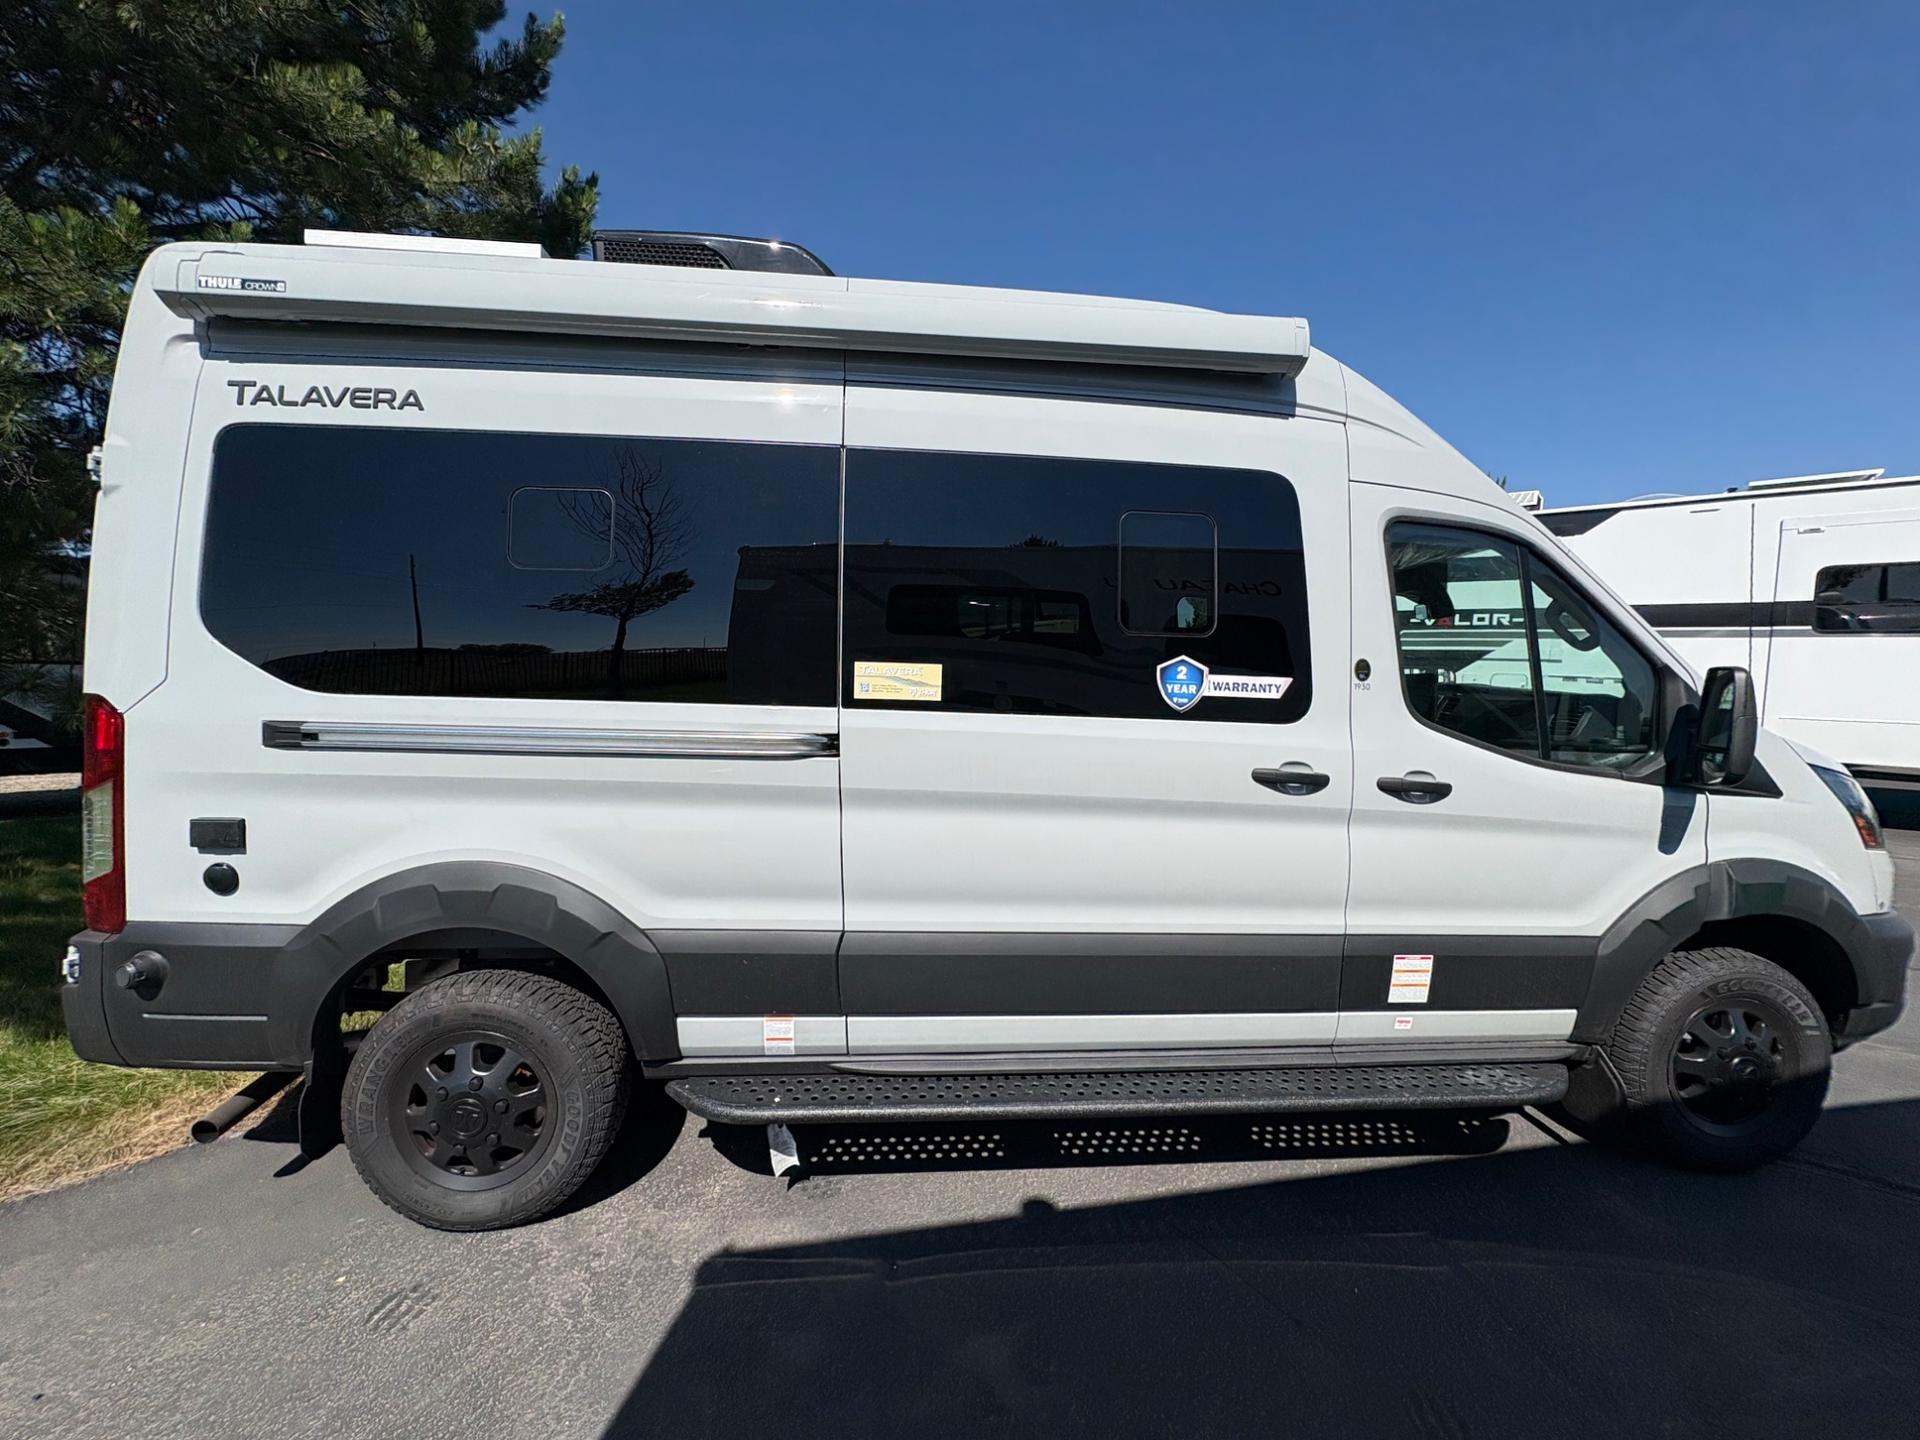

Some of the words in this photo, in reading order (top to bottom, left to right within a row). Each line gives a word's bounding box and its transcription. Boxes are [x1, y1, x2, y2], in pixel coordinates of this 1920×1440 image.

[199, 276, 242, 290] THULE
[227, 380, 424, 411] TALAVERA
[1176, 665, 1188, 680] 2
[1166, 683, 1198, 695] YEAR
[1212, 681, 1282, 694] WARRANTY
